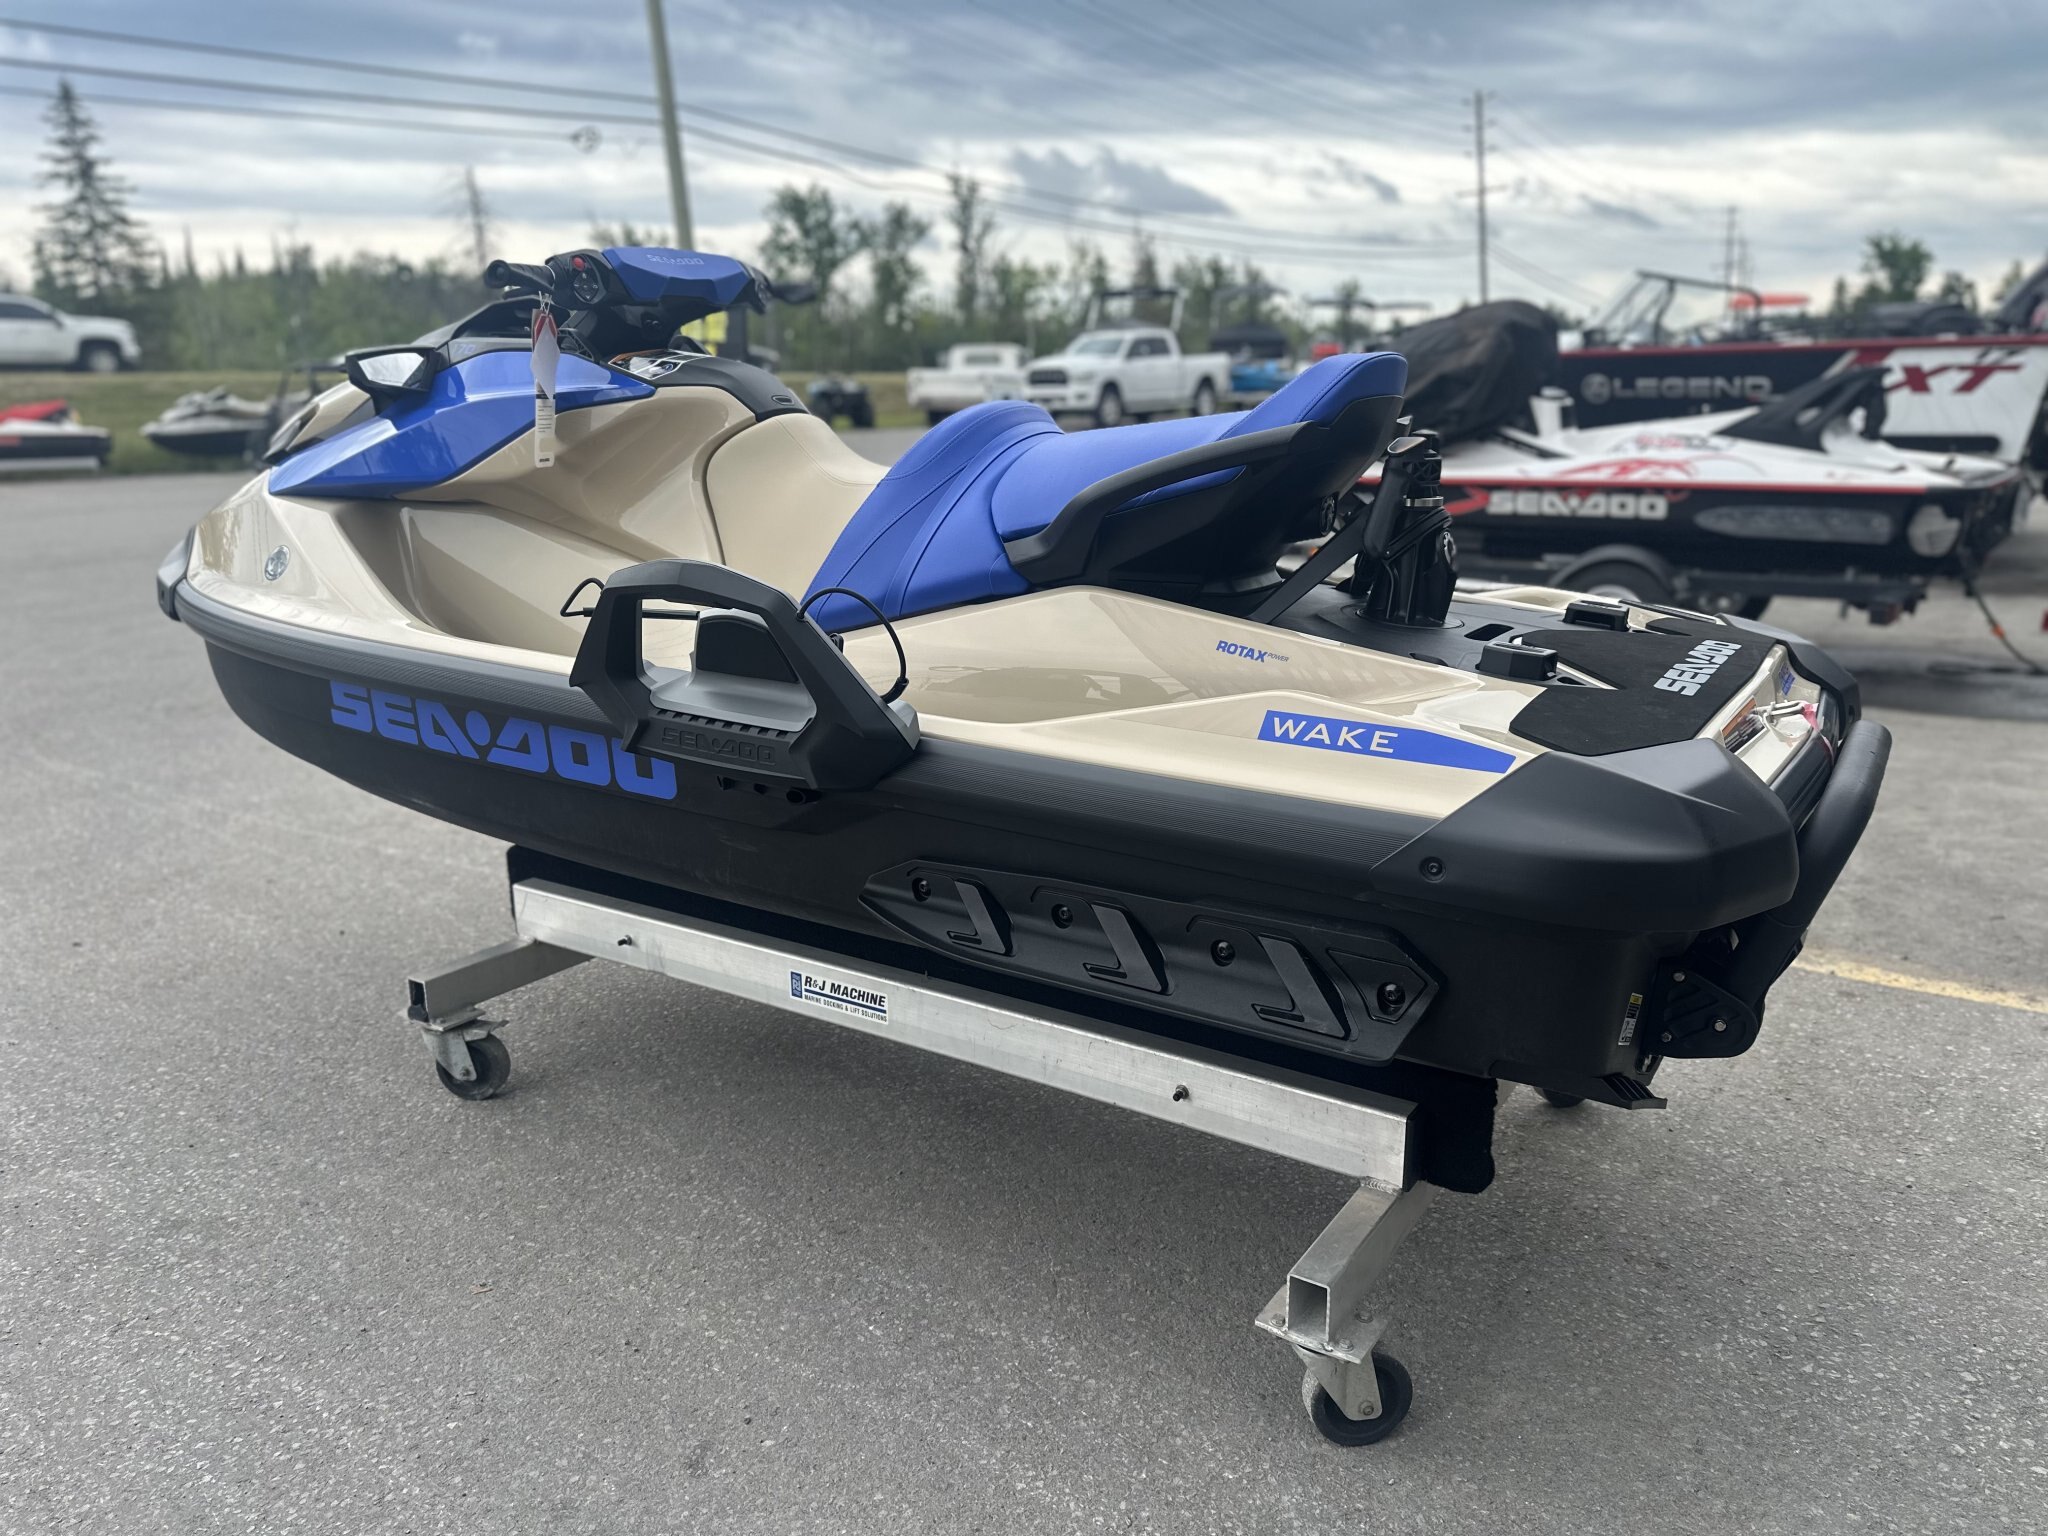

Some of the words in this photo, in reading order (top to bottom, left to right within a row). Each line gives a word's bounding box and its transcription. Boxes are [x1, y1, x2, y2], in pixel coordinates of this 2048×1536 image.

[1613, 376, 1773, 400] LEGEND
[1215, 640, 1268, 663] ROTAX
[1267, 652, 1290, 662] POWER
[1273, 716, 1399, 754] WAKE
[804, 975, 826, 991] R&J
[829, 982, 887, 1008] MACHINE
[804, 993, 822, 1005] MARINE
[823, 1000, 844, 1011] DOCKING
[845, 1004, 849, 1012] &
[849, 1006, 860, 1015] LIFT
[861, 1011, 887, 1022] SOLUTIONS
